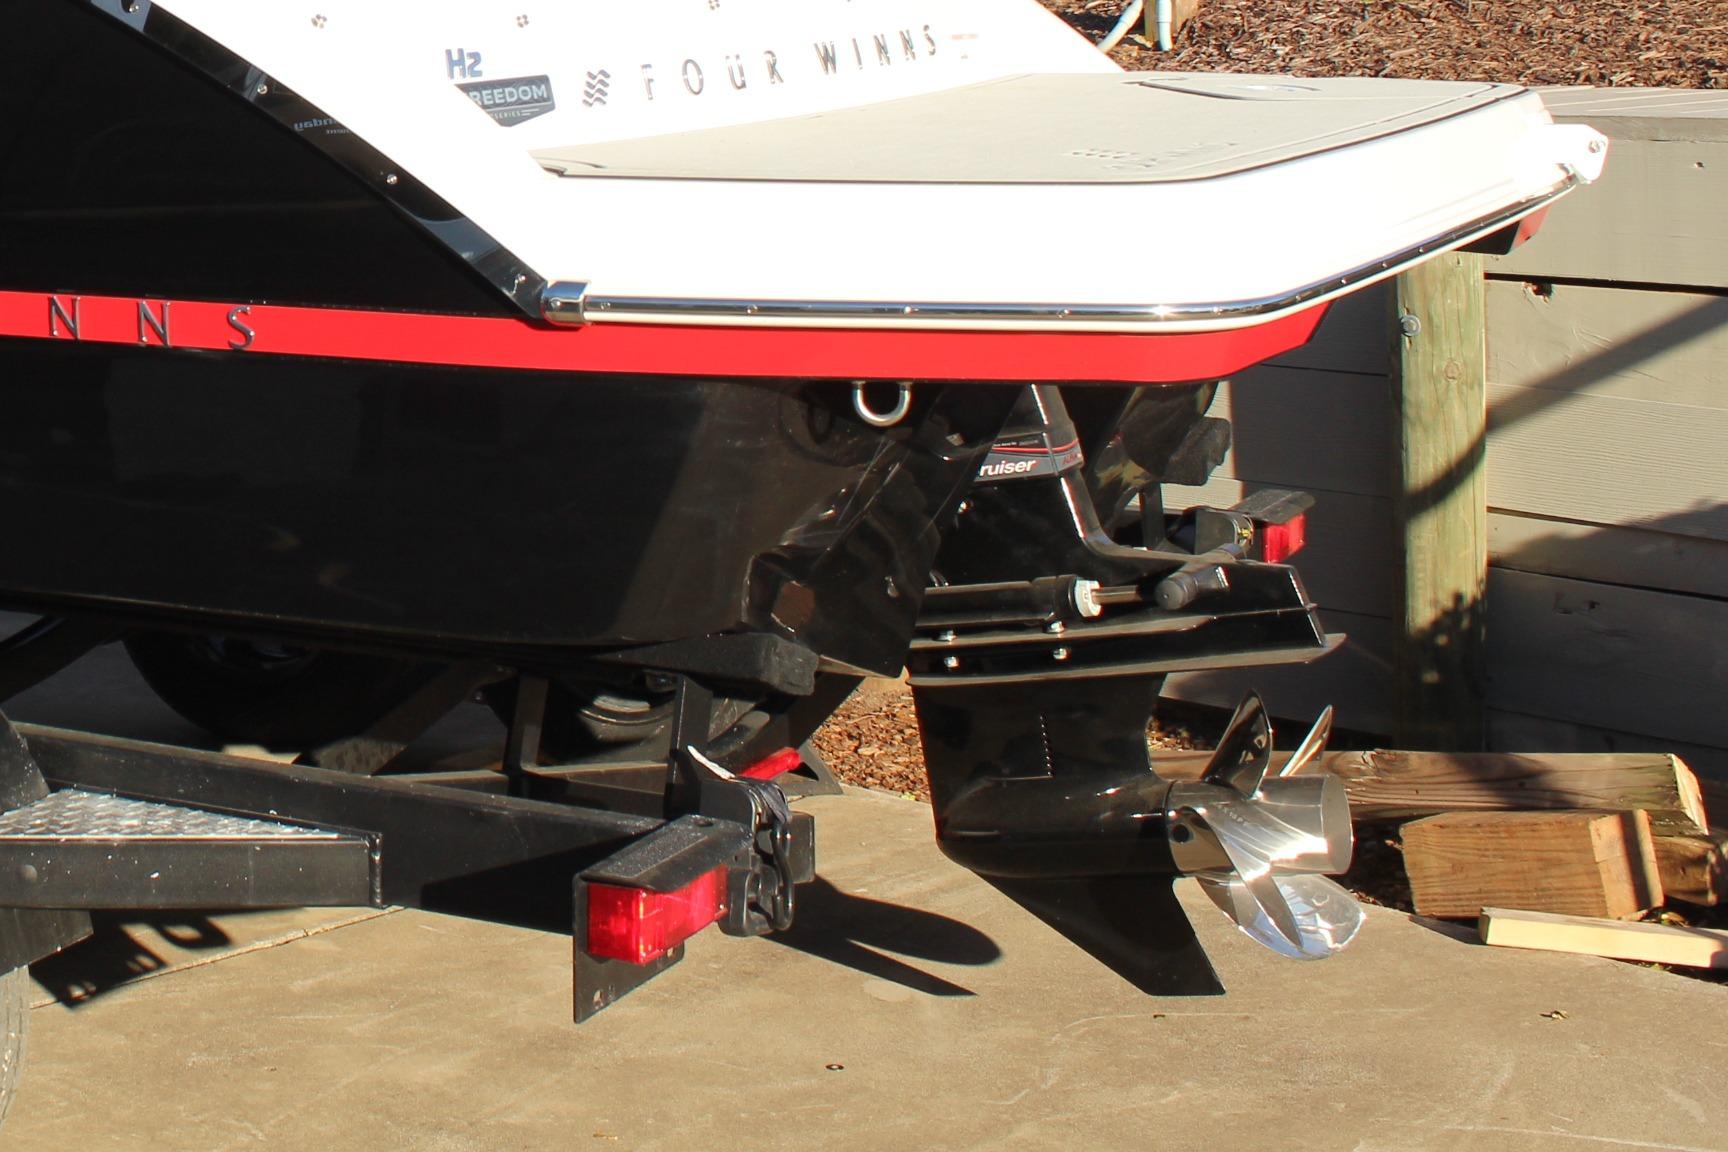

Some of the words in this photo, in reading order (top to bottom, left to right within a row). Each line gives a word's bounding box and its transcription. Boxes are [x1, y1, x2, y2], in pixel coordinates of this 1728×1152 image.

[445, 47, 483, 80] H2
[640, 49, 785, 101] FOUR
[813, 24, 937, 76] WINNS
[468, 83, 549, 107] REEDOM
[978, 459, 1037, 477] ruiser
